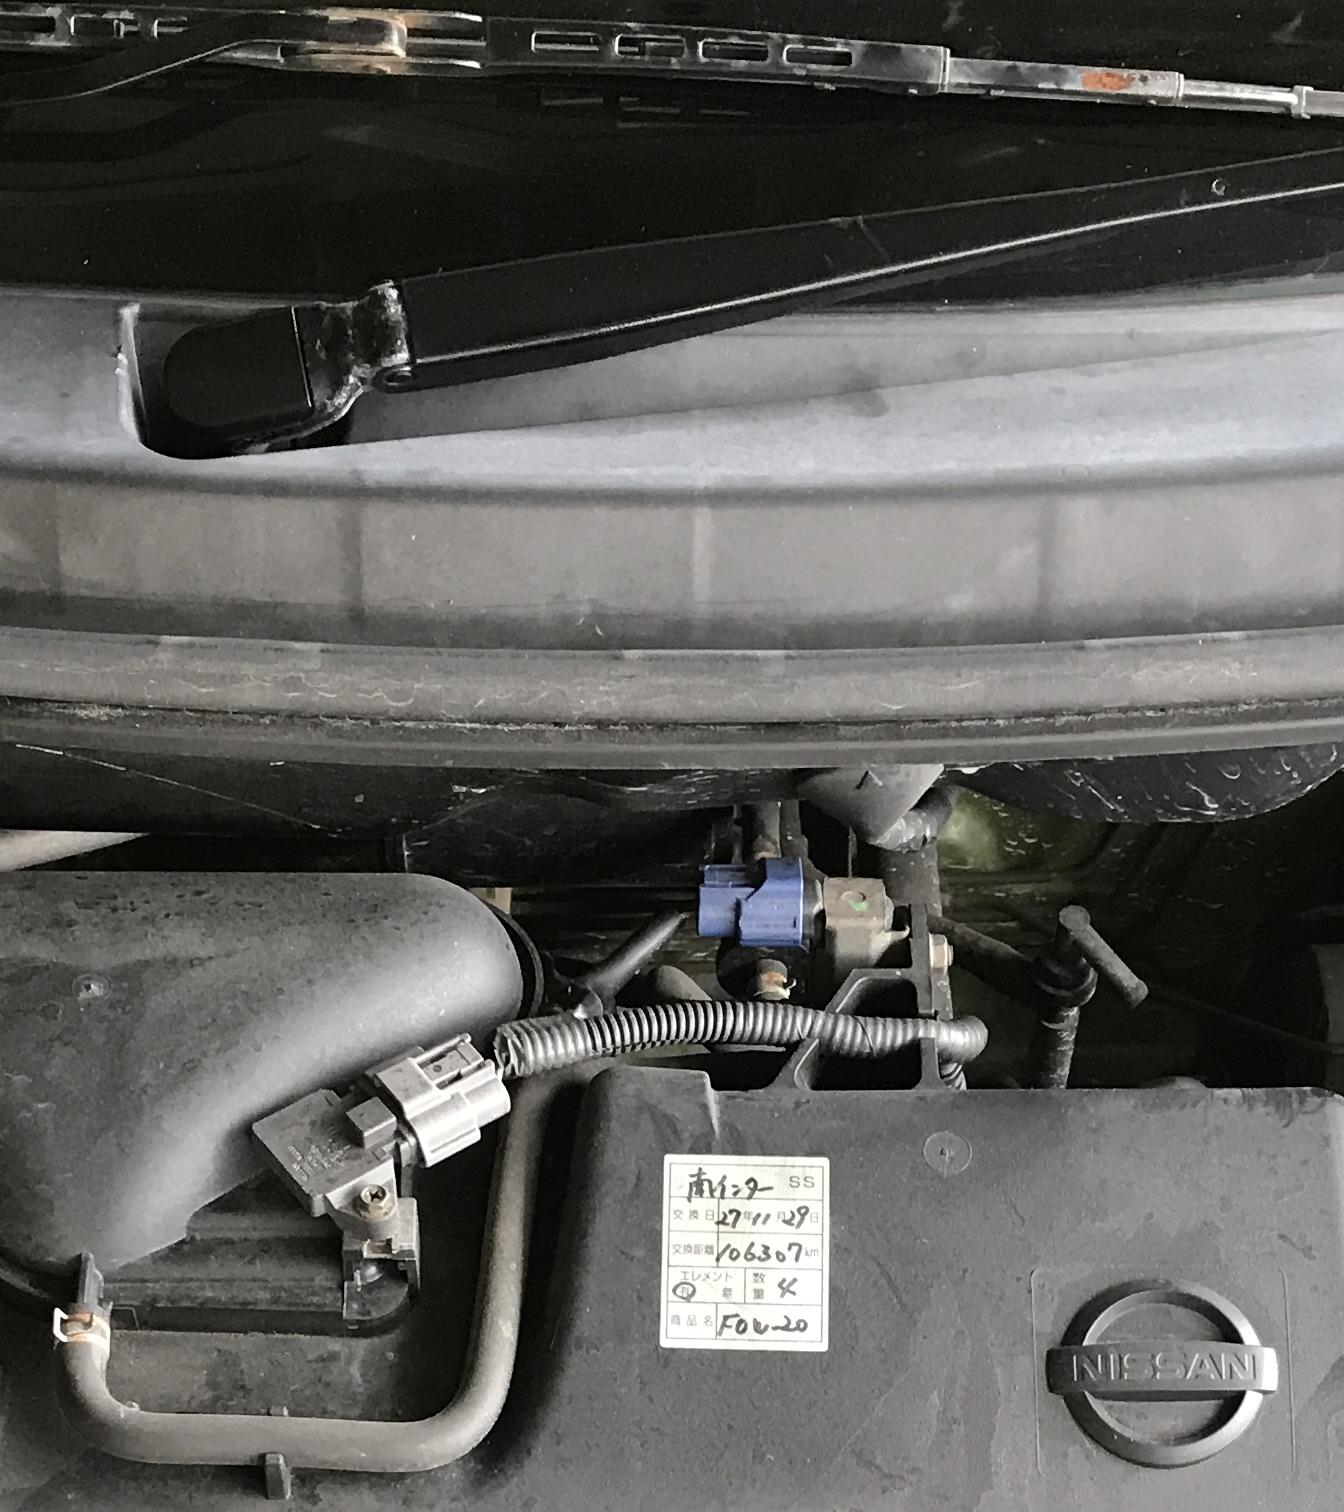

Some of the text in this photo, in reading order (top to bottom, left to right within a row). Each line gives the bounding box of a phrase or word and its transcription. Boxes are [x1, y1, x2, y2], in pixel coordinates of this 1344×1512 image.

[789, 1176, 815, 1188] SS
[681, 1271, 732, 1281] エレメント
[1072, 1352, 1256, 1382] NISSAN
